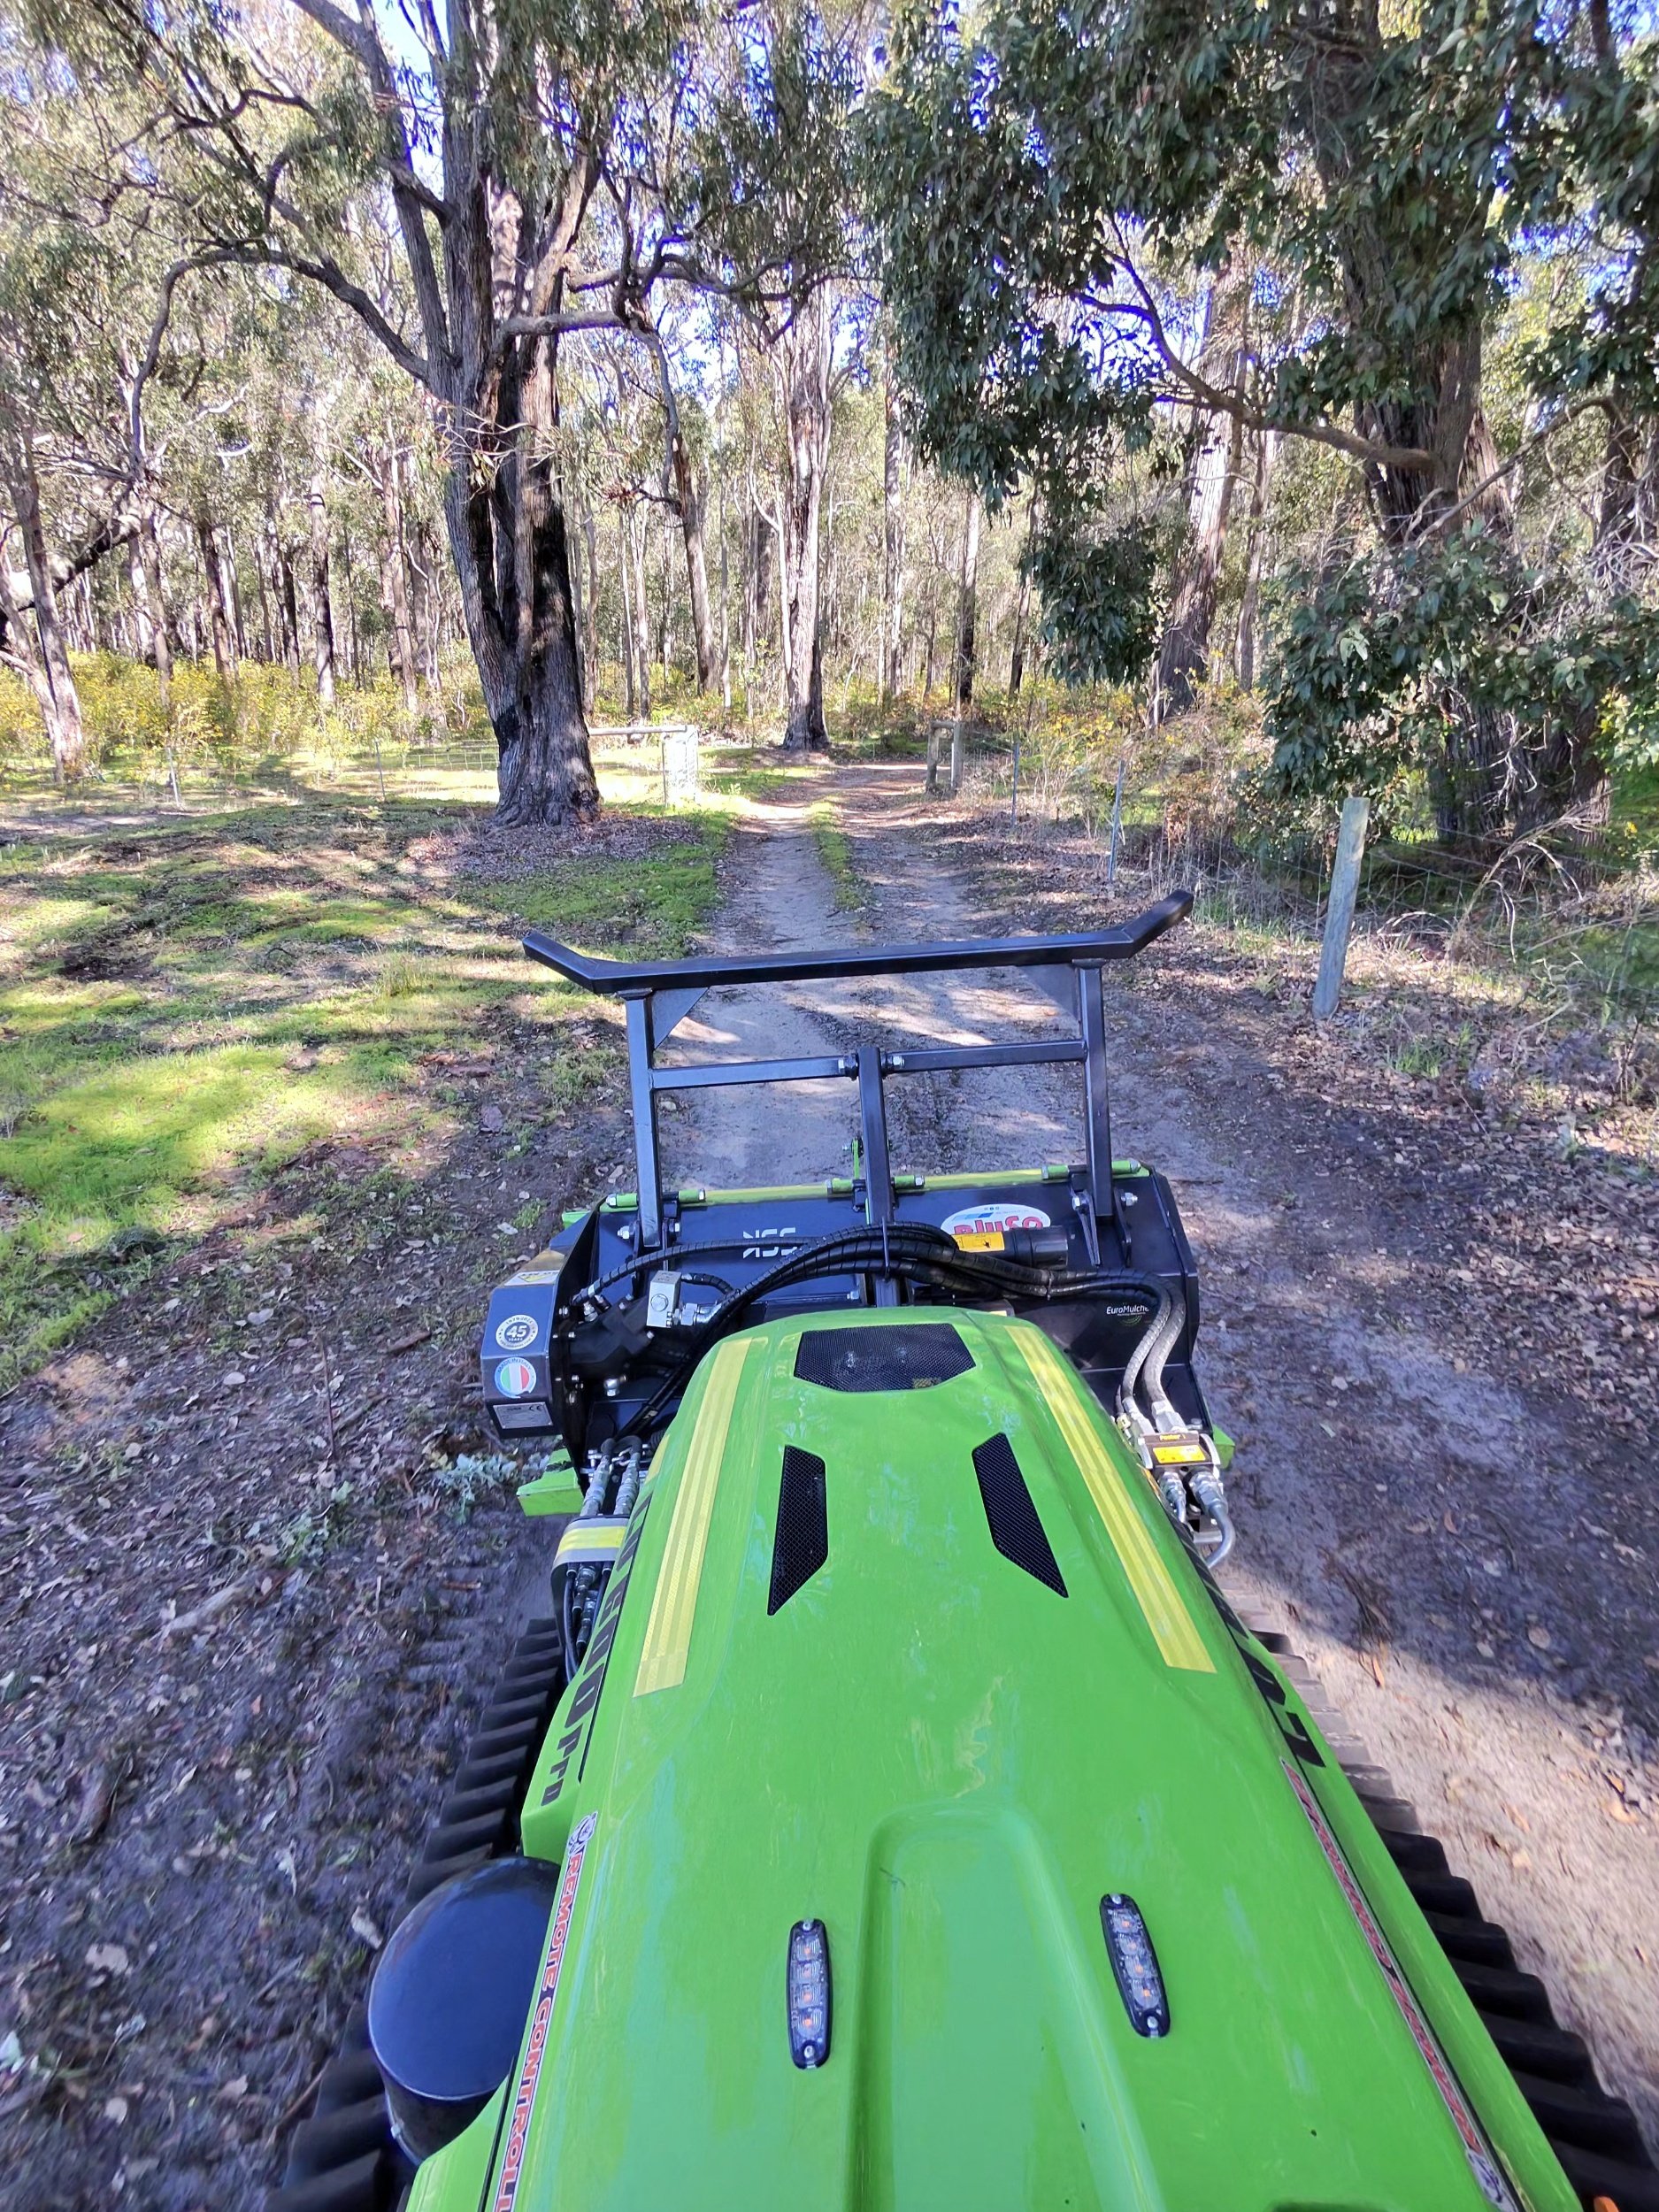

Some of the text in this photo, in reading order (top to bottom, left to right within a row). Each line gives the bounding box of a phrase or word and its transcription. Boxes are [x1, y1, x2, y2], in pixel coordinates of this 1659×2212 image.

[506, 1325, 527, 1338] 45
[496, 1359, 511, 1373] MADE
[541, 1855, 584, 1992] REMOTE
